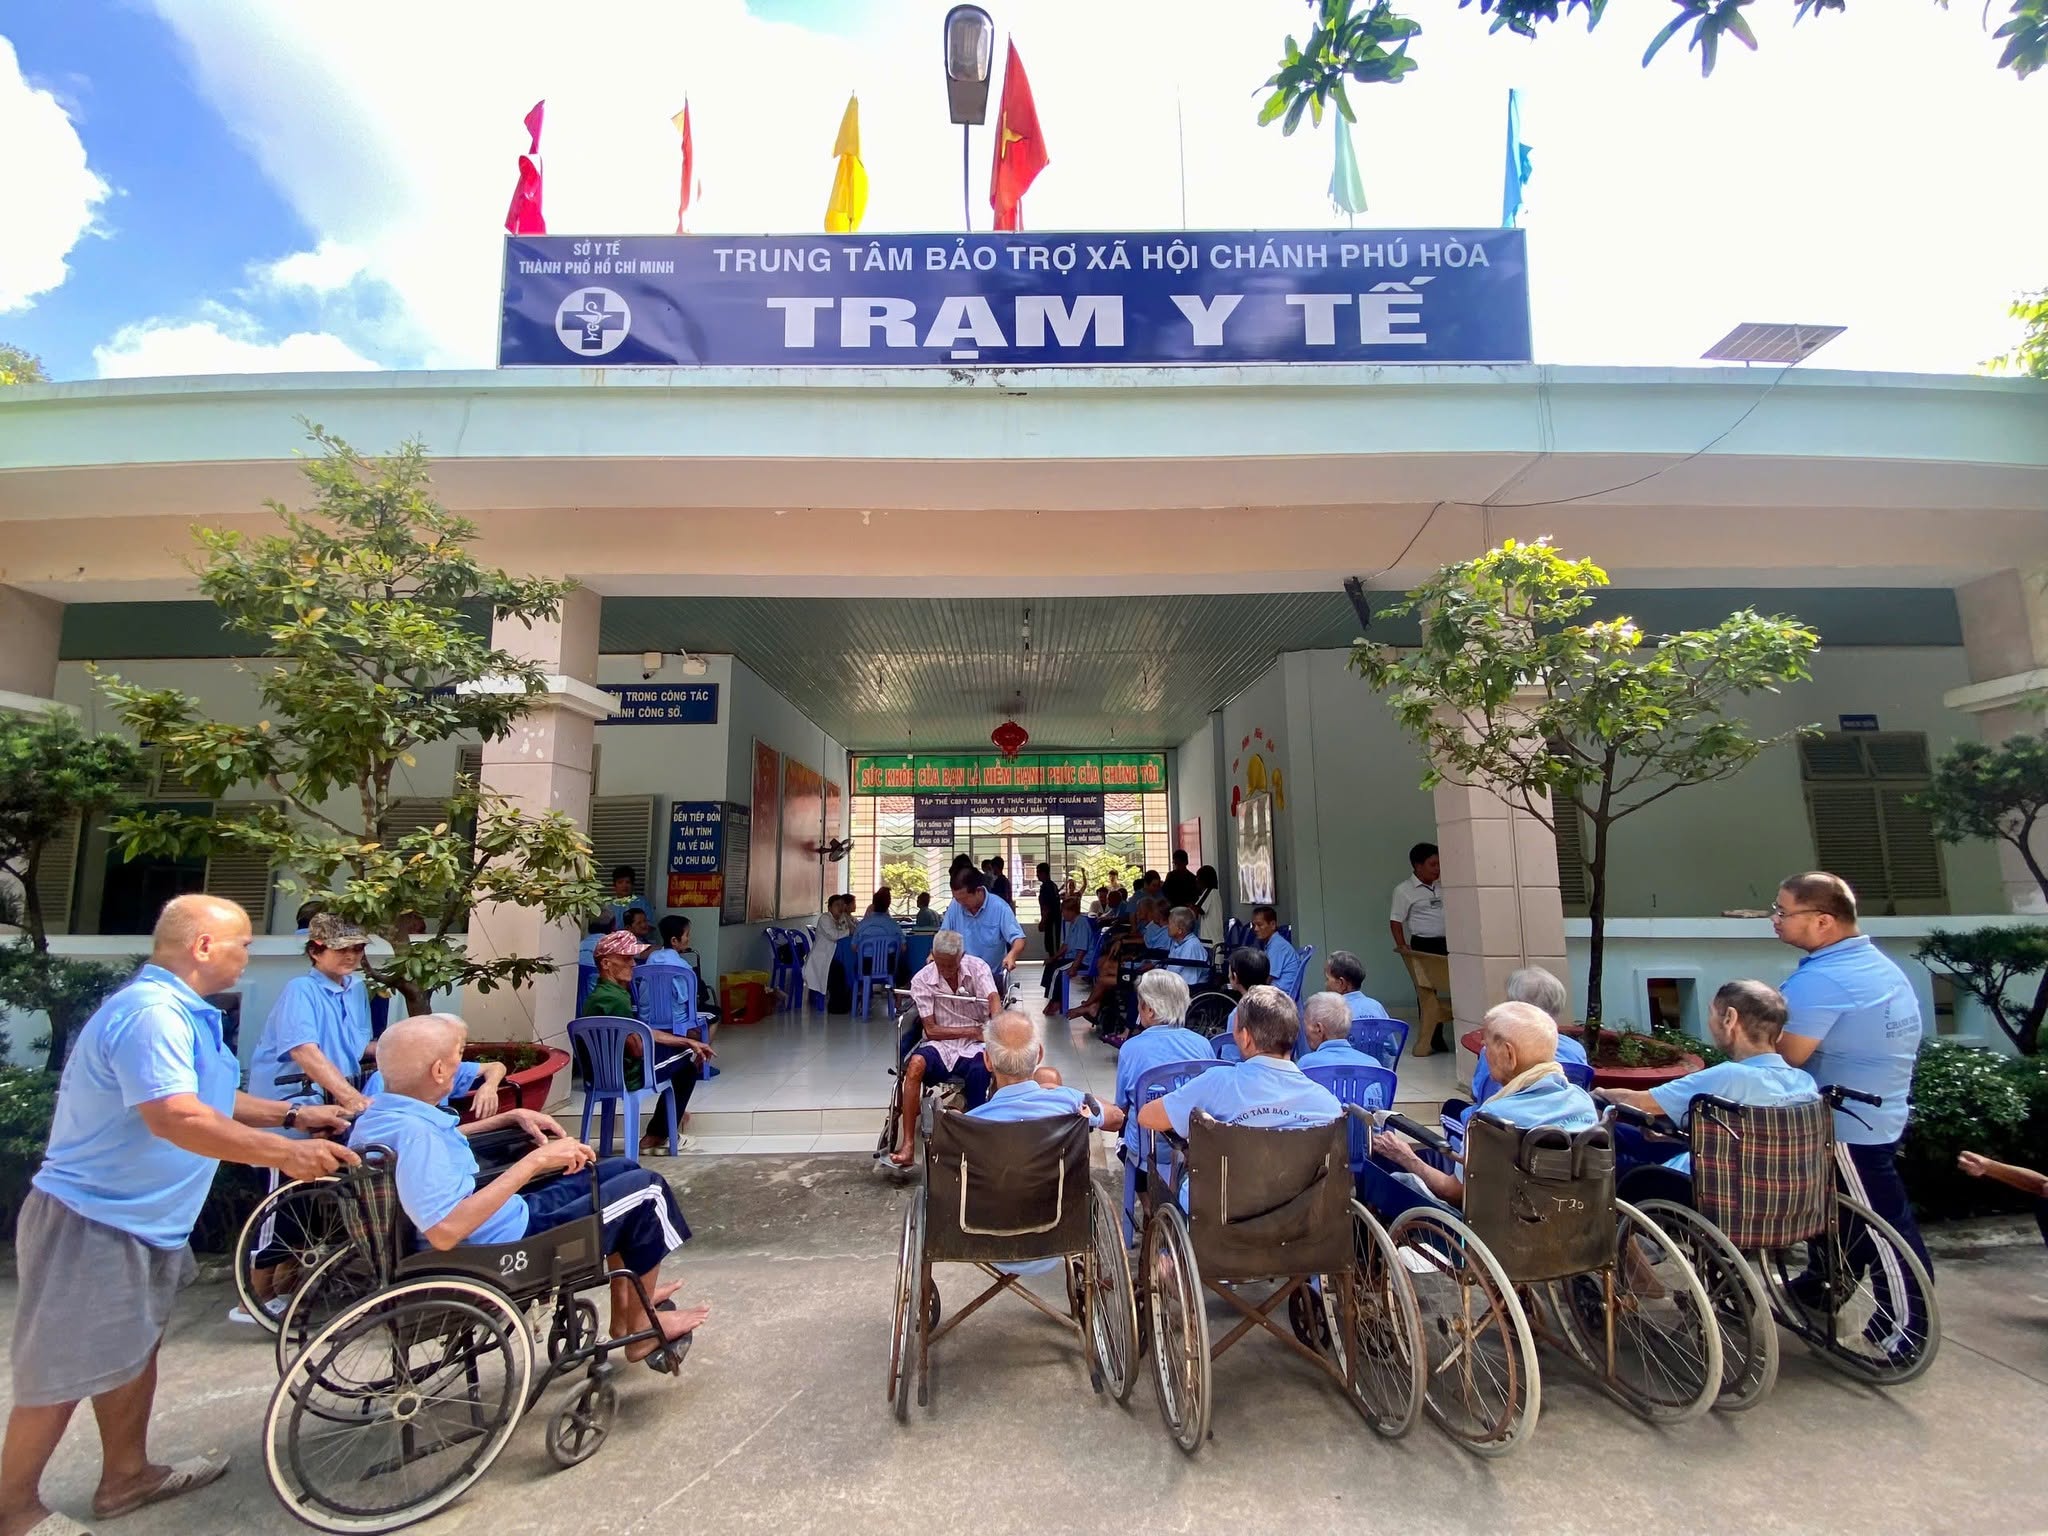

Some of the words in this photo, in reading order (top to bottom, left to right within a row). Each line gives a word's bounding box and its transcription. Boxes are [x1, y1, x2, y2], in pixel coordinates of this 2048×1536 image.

[573, 239, 590, 256] SỞ
[593, 243, 603, 256] Y
[605, 239, 621, 256] TẾ
[713, 247, 832, 273] TRUNG
[843, 240, 913, 272] TÂM
[926, 238, 997, 271] BẢO
[1006, 243, 1077, 275] TRỢ
[1086, 239, 1130, 271] XÃ
[1143, 239, 1199, 275] HỘI
[1210, 238, 1328, 270] CHÁNH
[1341, 238, 1409, 268] PHÚ
[1420, 237, 1490, 268] HÒA
[519, 258, 562, 275] THÀNH
[564, 257, 591, 275] PHỐ
[594, 258, 611, 275] HỒ
[615, 258, 637, 274] CHÍ
[640, 260, 675, 274] MINH
[766, 295, 1125, 360] TRẠM
[1168, 294, 1245, 347] Y
[1285, 275, 1437, 345] TẾ
[626, 691, 658, 702] TRONG
[660, 689, 687, 702] CÔNG
[690, 689, 709, 701] TÁC
[638, 706, 665, 718] CÔNG
[861, 762, 883, 788] SỨC
[918, 762, 940, 787] CỦA
[942, 767, 965, 792] BẠN
[967, 761, 981, 787] LÀ
[983, 757, 1012, 786] NIỀM
[1013, 766, 1045, 791] HẠNH
[1047, 760, 1076, 785] PHÚC
[1078, 760, 1100, 785] CỦA
[1102, 760, 1139, 785] CHÚNG
[1140, 760, 1159, 784] TÔI
[673, 810, 688, 822] ĐẾN
[689, 810, 705, 822] TIẾP
[706, 811, 721, 822] ĐÓN
[680, 825, 694, 839] TẬN
[696, 824, 713, 837] TÌNH
[676, 841, 686, 851] RA
[685, 856, 700, 865] CHU
[499, 1250, 529, 1277] 28
